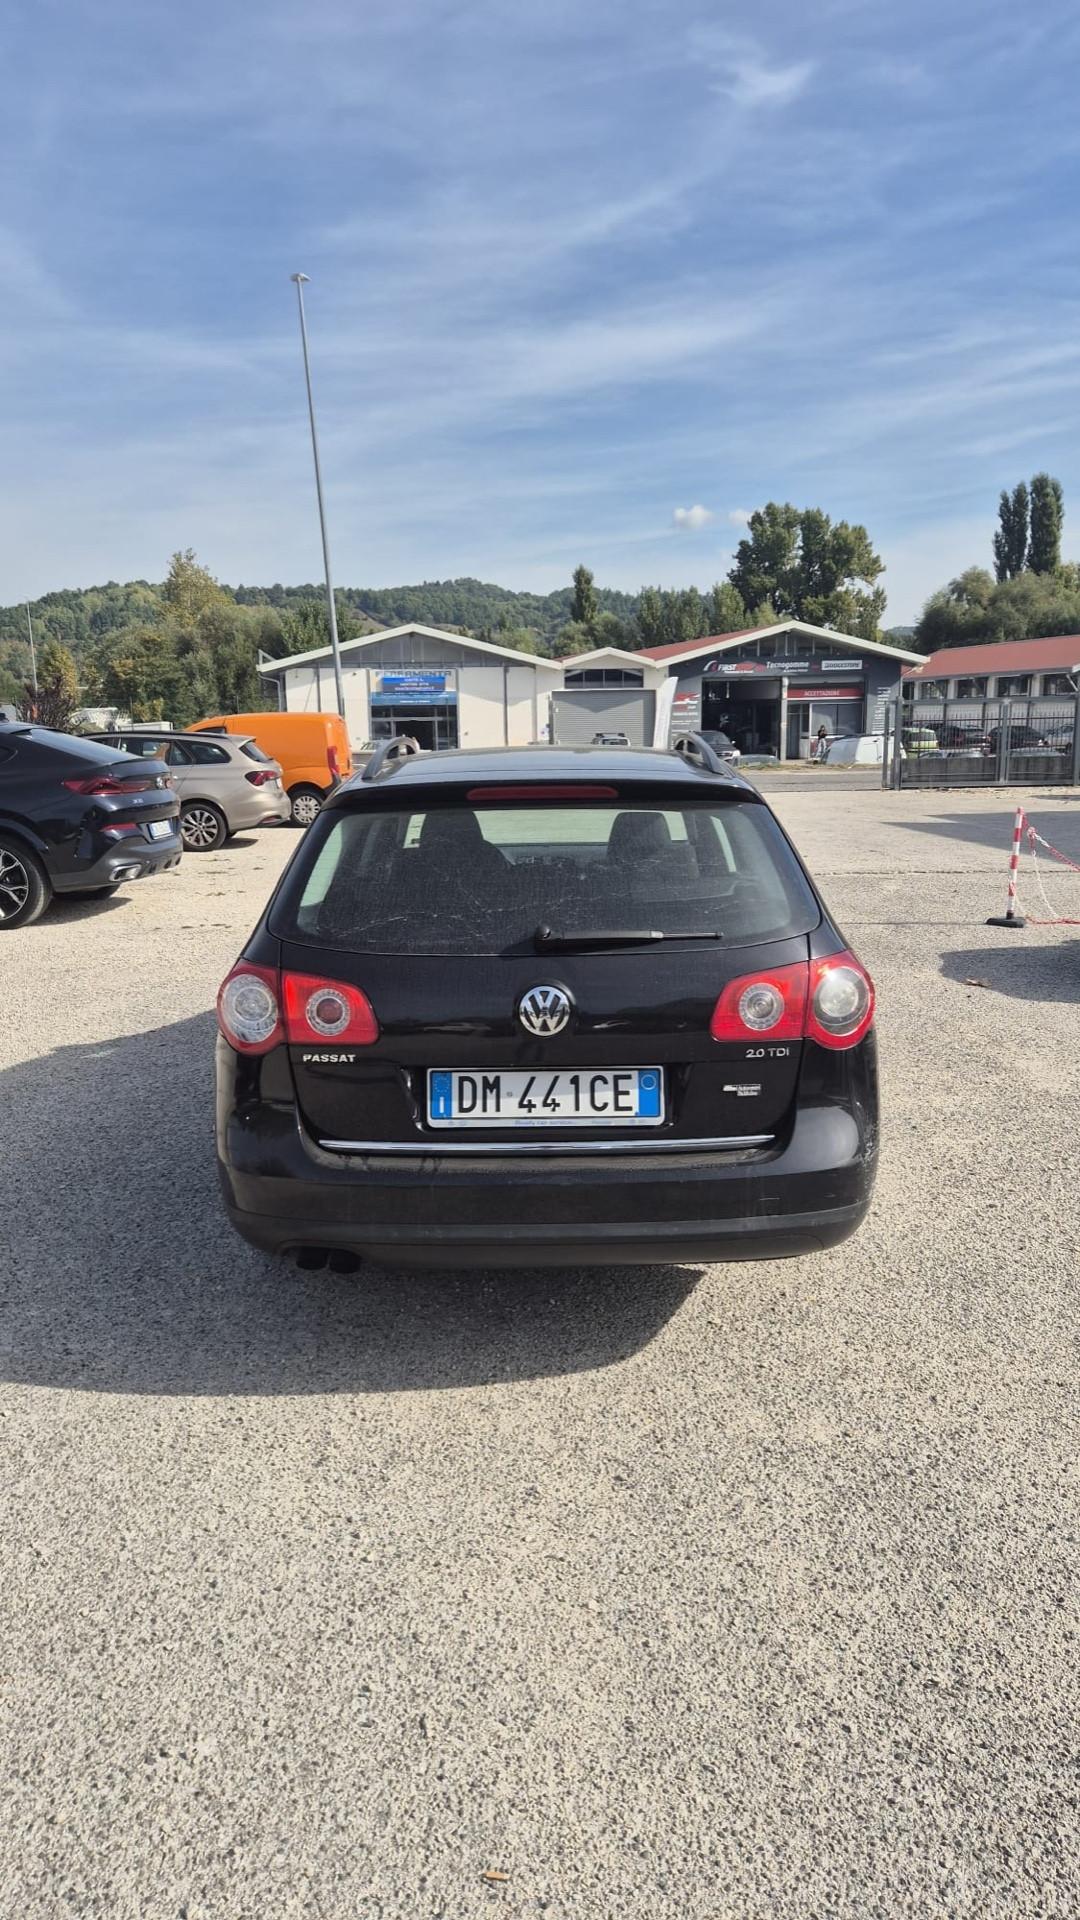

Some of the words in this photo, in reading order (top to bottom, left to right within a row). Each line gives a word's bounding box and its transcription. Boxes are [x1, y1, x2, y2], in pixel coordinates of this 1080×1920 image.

[768, 1047, 790, 1057] TDI
[302, 1054, 356, 1062] PASSAT
[457, 1075, 501, 1113] DM
[518, 1074, 633, 1113] 441CE
